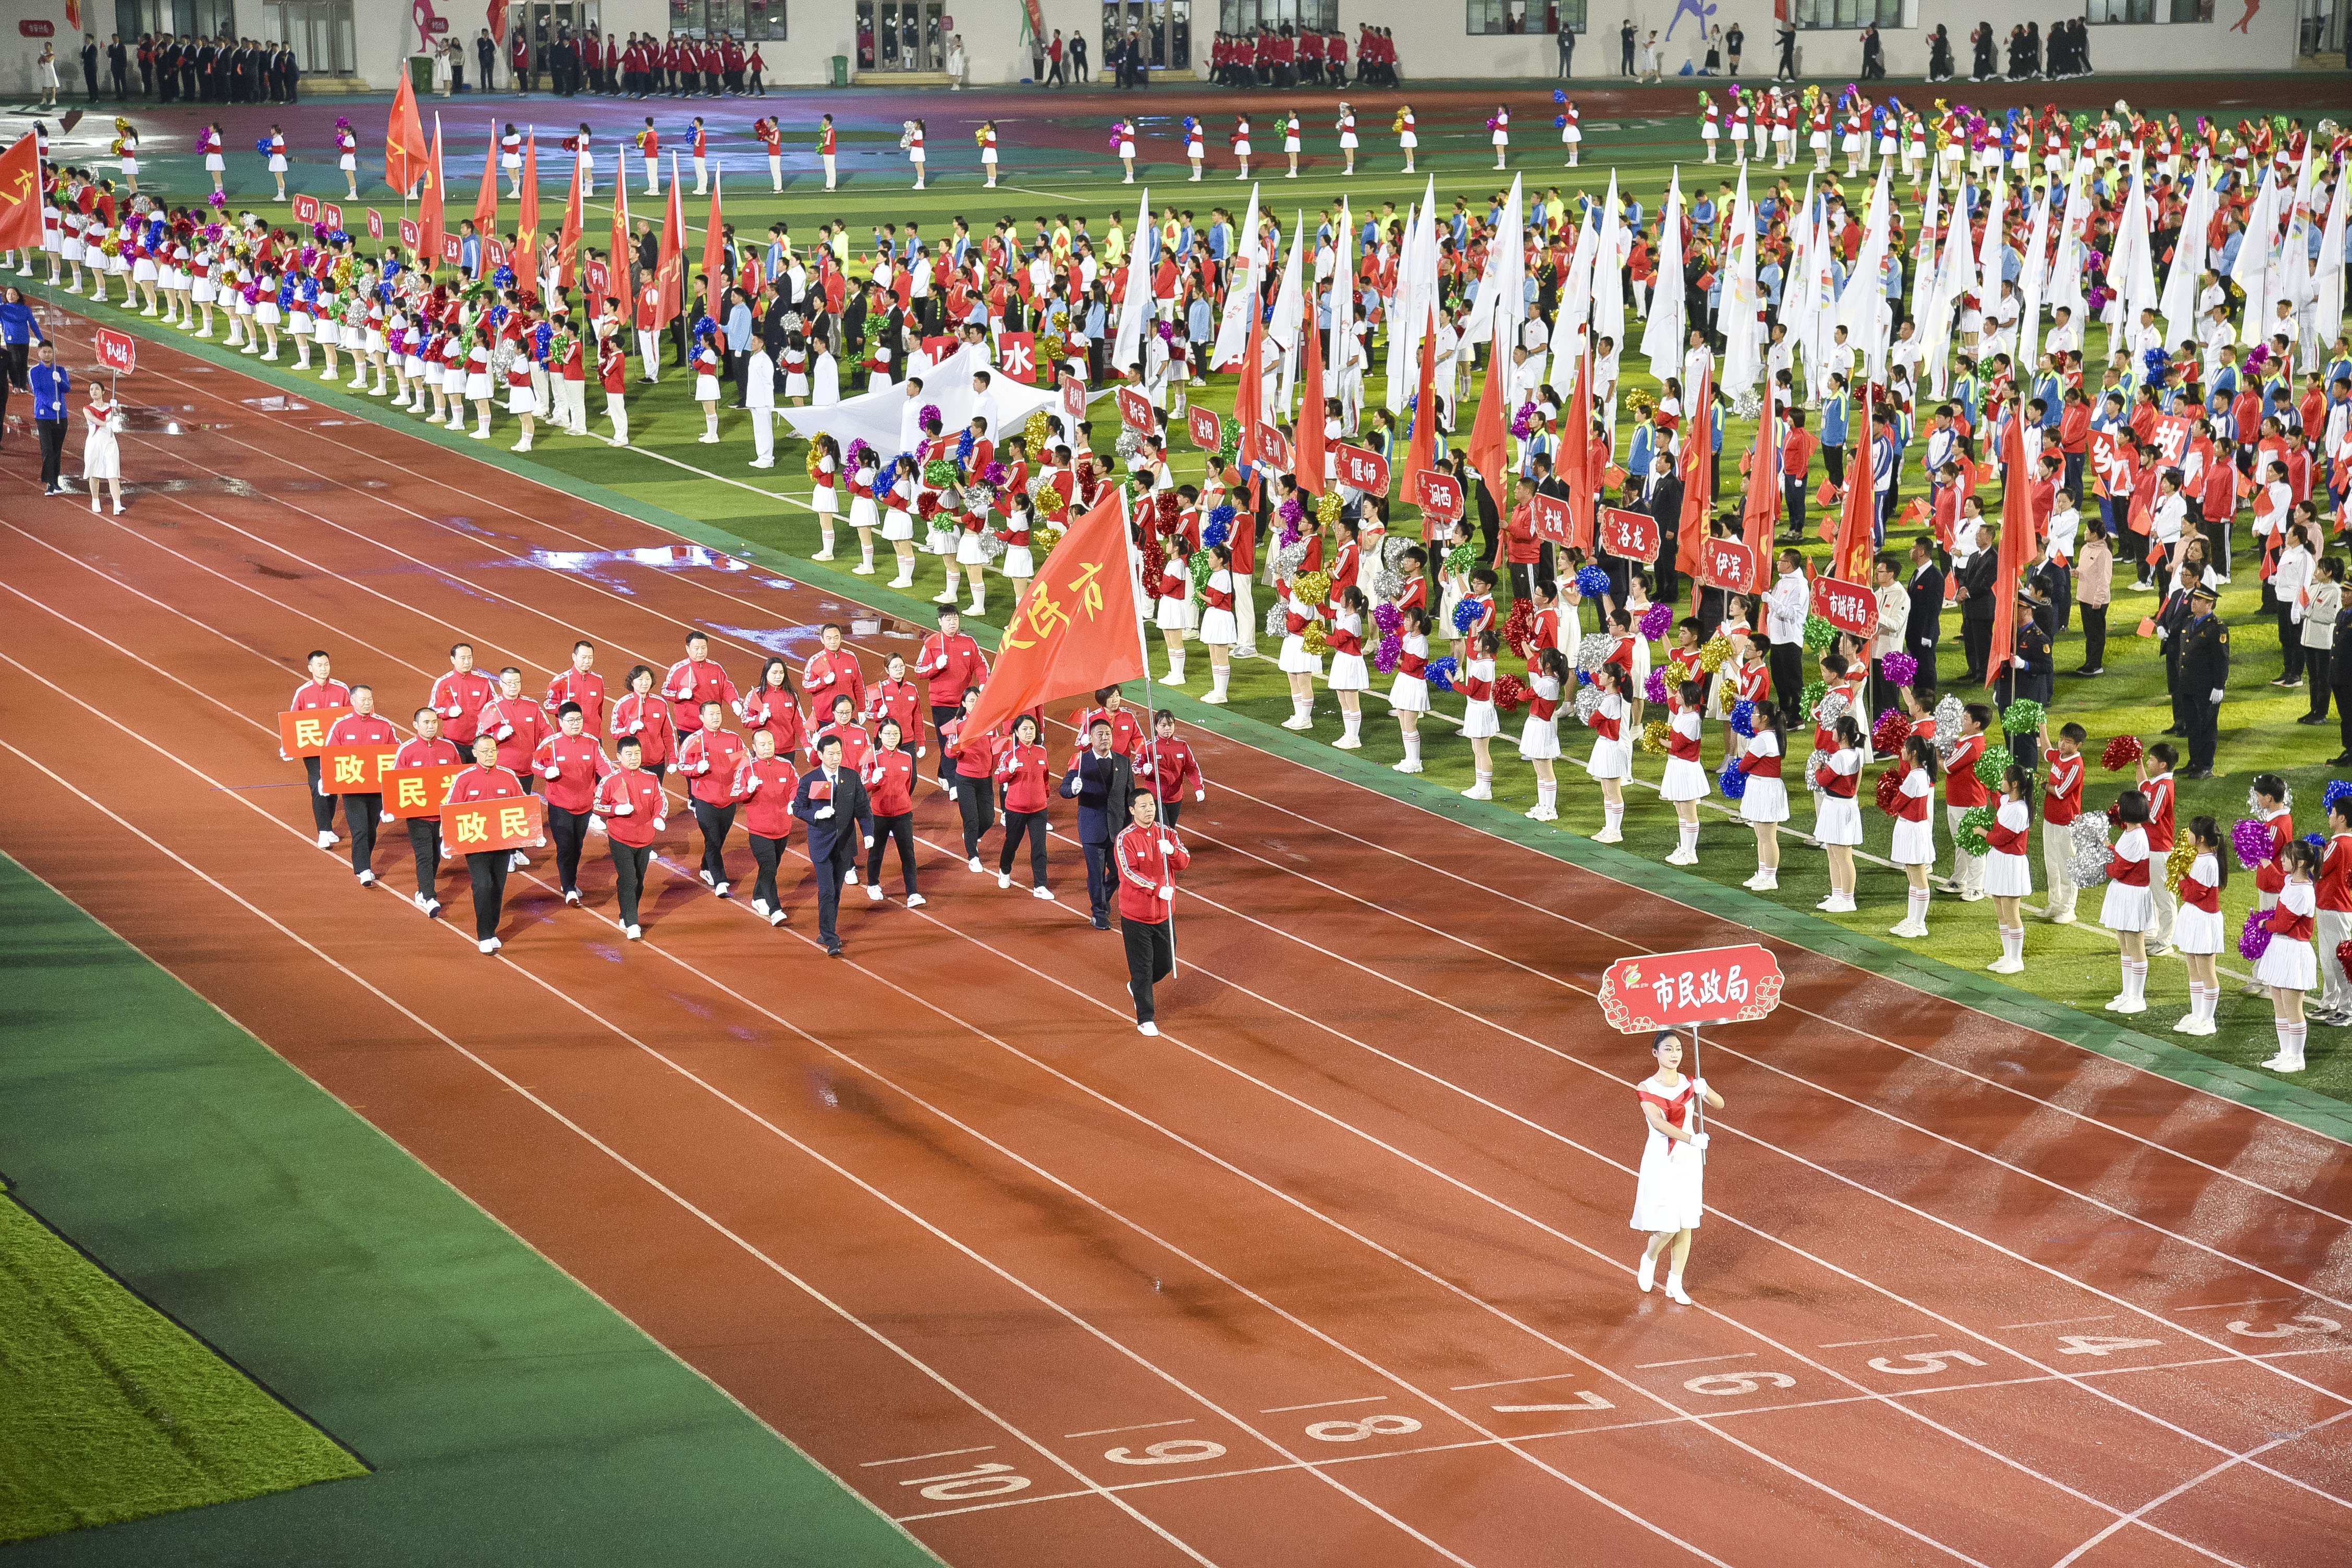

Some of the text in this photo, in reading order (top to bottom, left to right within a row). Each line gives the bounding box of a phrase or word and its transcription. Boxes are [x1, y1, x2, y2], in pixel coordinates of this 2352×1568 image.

[300, 201, 313, 219] 龙门
[404, 226, 415, 243] 西工
[447, 240, 458, 260] 孟津
[591, 268, 604, 287] 伊川
[106, 338, 128, 365] 市人社局
[1001, 341, 1034, 375] 水
[1129, 398, 1147, 426] 新安
[1197, 416, 1214, 441] 汝阳
[2153, 420, 2184, 461] 故
[1265, 434, 1280, 463] 栾川
[2092, 435, 2114, 473] 乡
[1350, 456, 1376, 485] 偃师
[1429, 482, 1452, 508] 涧西
[1544, 506, 1564, 537] 老城
[1618, 521, 1645, 551] 洛龙
[1716, 551, 1741, 582] 伊滨
[1829, 591, 1866, 626] 市城管局
[455, 806, 530, 844] 政民
[1651, 964, 1749, 1013] 市民政局
[2225, 1315, 2342, 1339] 3
[2056, 1336, 2165, 1356] 4
[1867, 1349, 1988, 1375] 5
[1683, 1371, 1797, 1396] 6
[1490, 1390, 1616, 1413] 7
[1305, 1414, 1423, 1442] 8
[1104, 1439, 1227, 1465] 9
[899, 1463, 1032, 1500] 10
